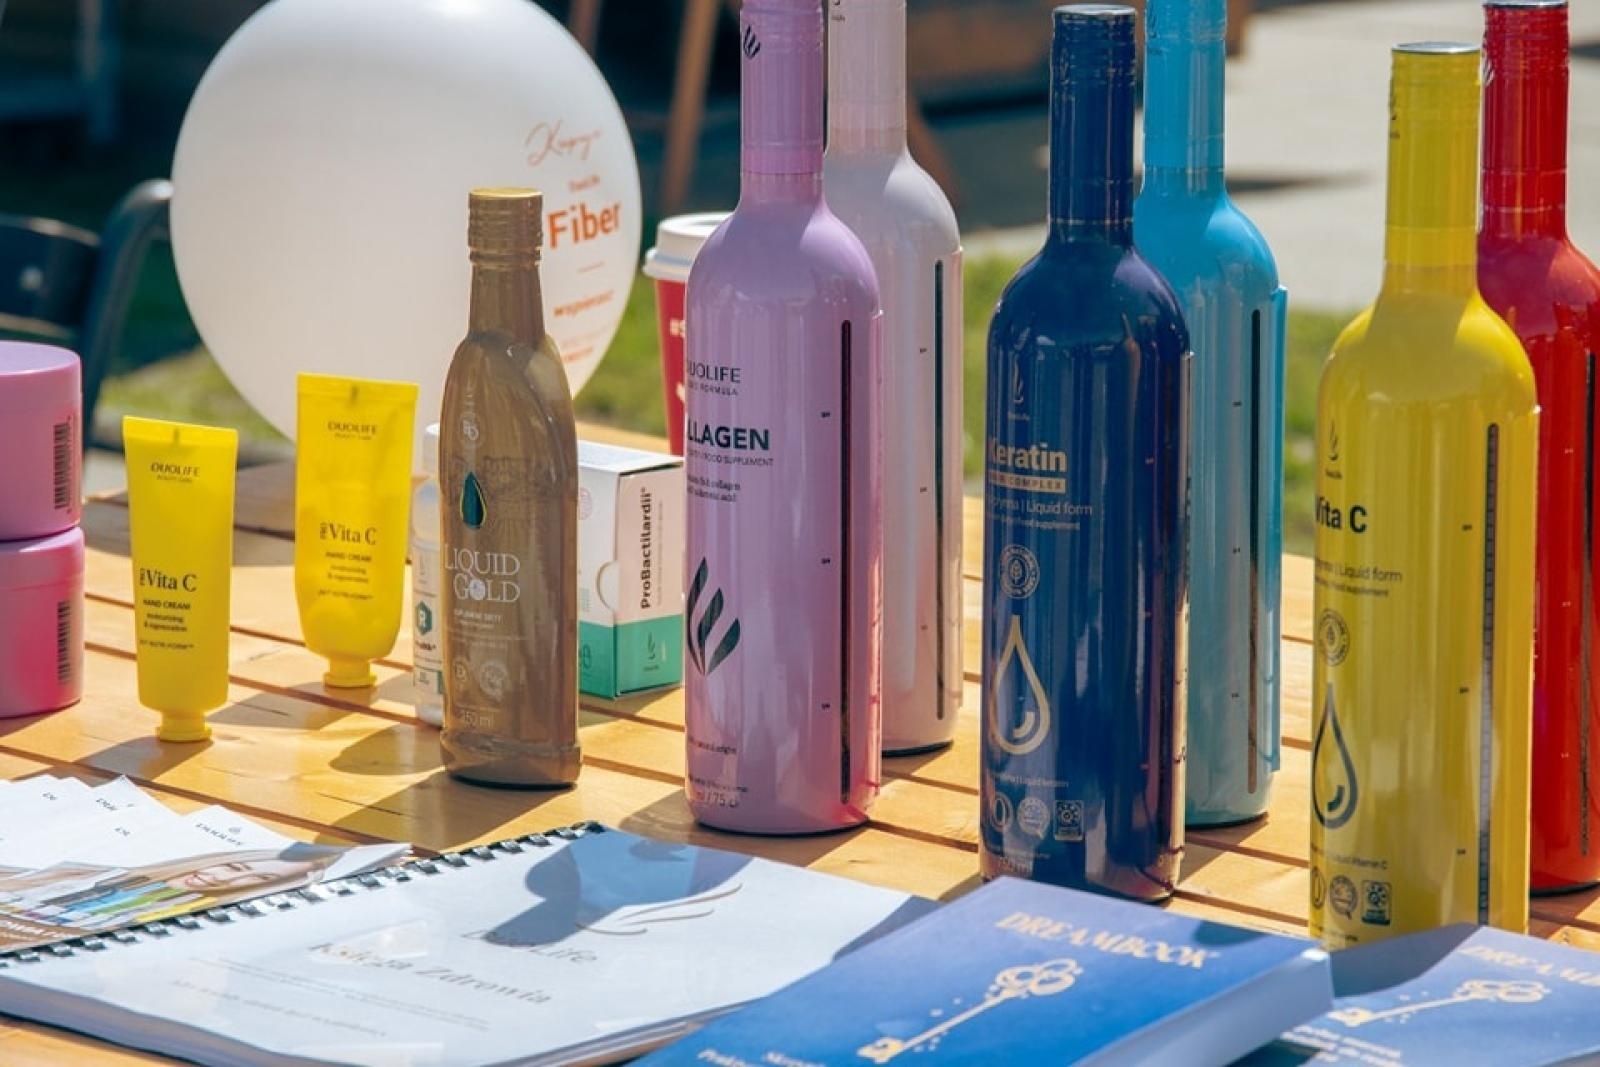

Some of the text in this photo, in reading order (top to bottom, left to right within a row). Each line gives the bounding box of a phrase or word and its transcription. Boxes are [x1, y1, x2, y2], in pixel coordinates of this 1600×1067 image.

[548, 201, 621, 250] Fiber
[687, 361, 742, 383] UOLIFE
[1064, 501, 1093, 516] form
[1349, 504, 1368, 534] C
[329, 522, 361, 544] Vita
[364, 526, 378, 546] C
[445, 544, 520, 578] LIQUID
[147, 569, 178, 590] Vita
[183, 573, 197, 593] C
[454, 573, 520, 602] GOLD
[995, 911, 1219, 969] DREAMBOOK
[414, 967, 552, 1004] Zdrowia
